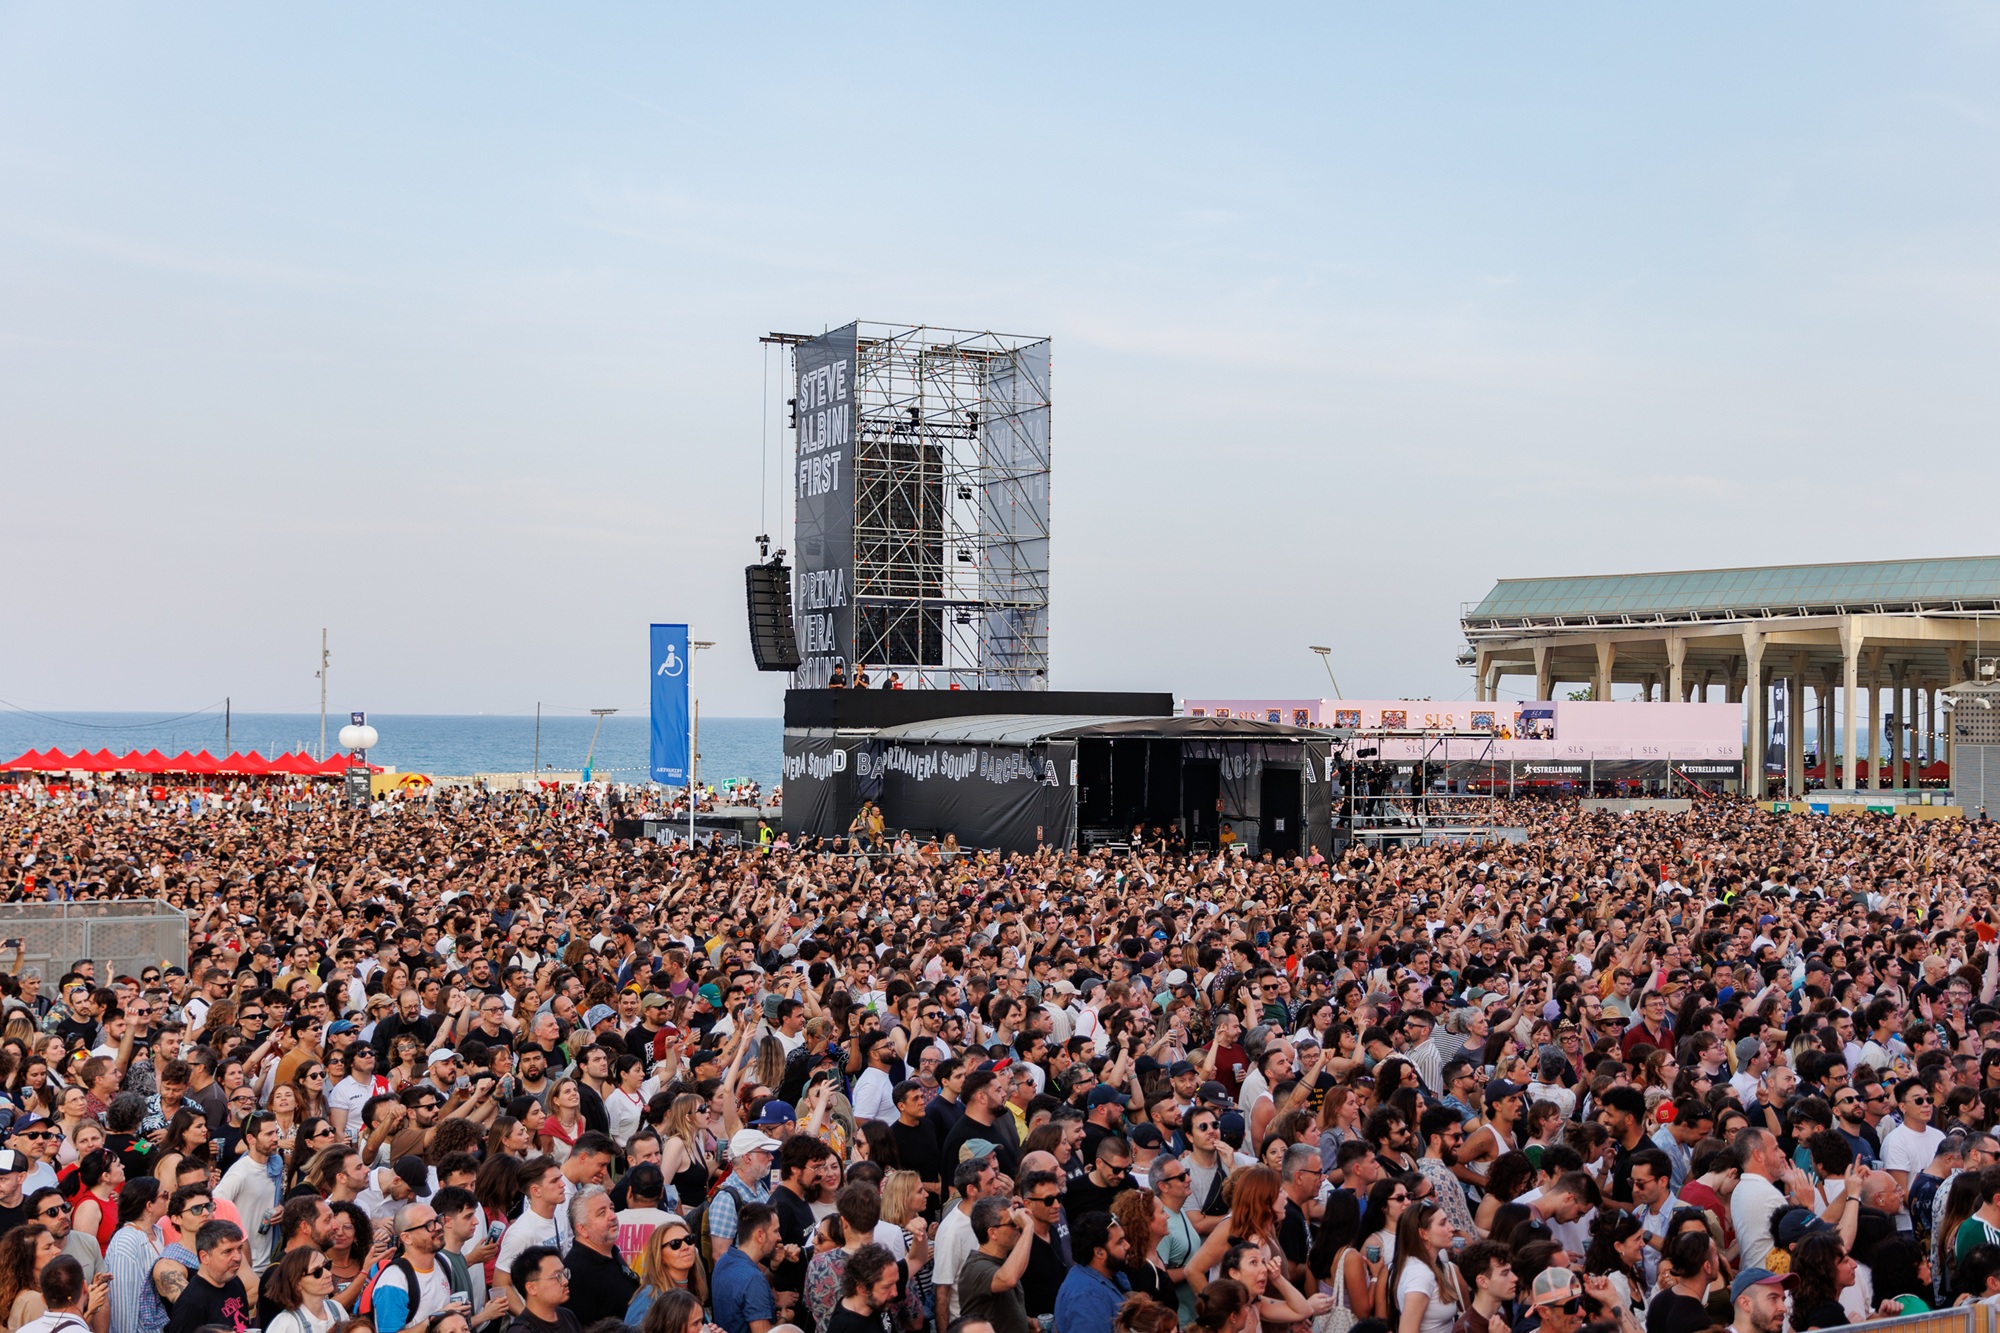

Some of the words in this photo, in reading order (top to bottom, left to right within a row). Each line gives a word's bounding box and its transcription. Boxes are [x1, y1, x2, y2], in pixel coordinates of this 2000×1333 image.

[800, 359, 847, 413] STEVE
[800, 404, 849, 456] ALBINI
[800, 451, 842, 498] FIRST
[799, 568, 848, 610] PRIMA
[798, 612, 836, 652] VERA
[1425, 713, 1454, 726] SLS
[883, 746, 938, 781] PRIMAVERA
[941, 748, 978, 781] SOUND
[1568, 746, 1584, 754] SLS
[1643, 746, 1659, 754] SLS
[1533, 766, 1563, 774] ESTRELLA
[1563, 766, 1582, 774] DAMM
[1688, 766, 1716, 774] ESTRELLA
[1716, 766, 1734, 774] DAMM
